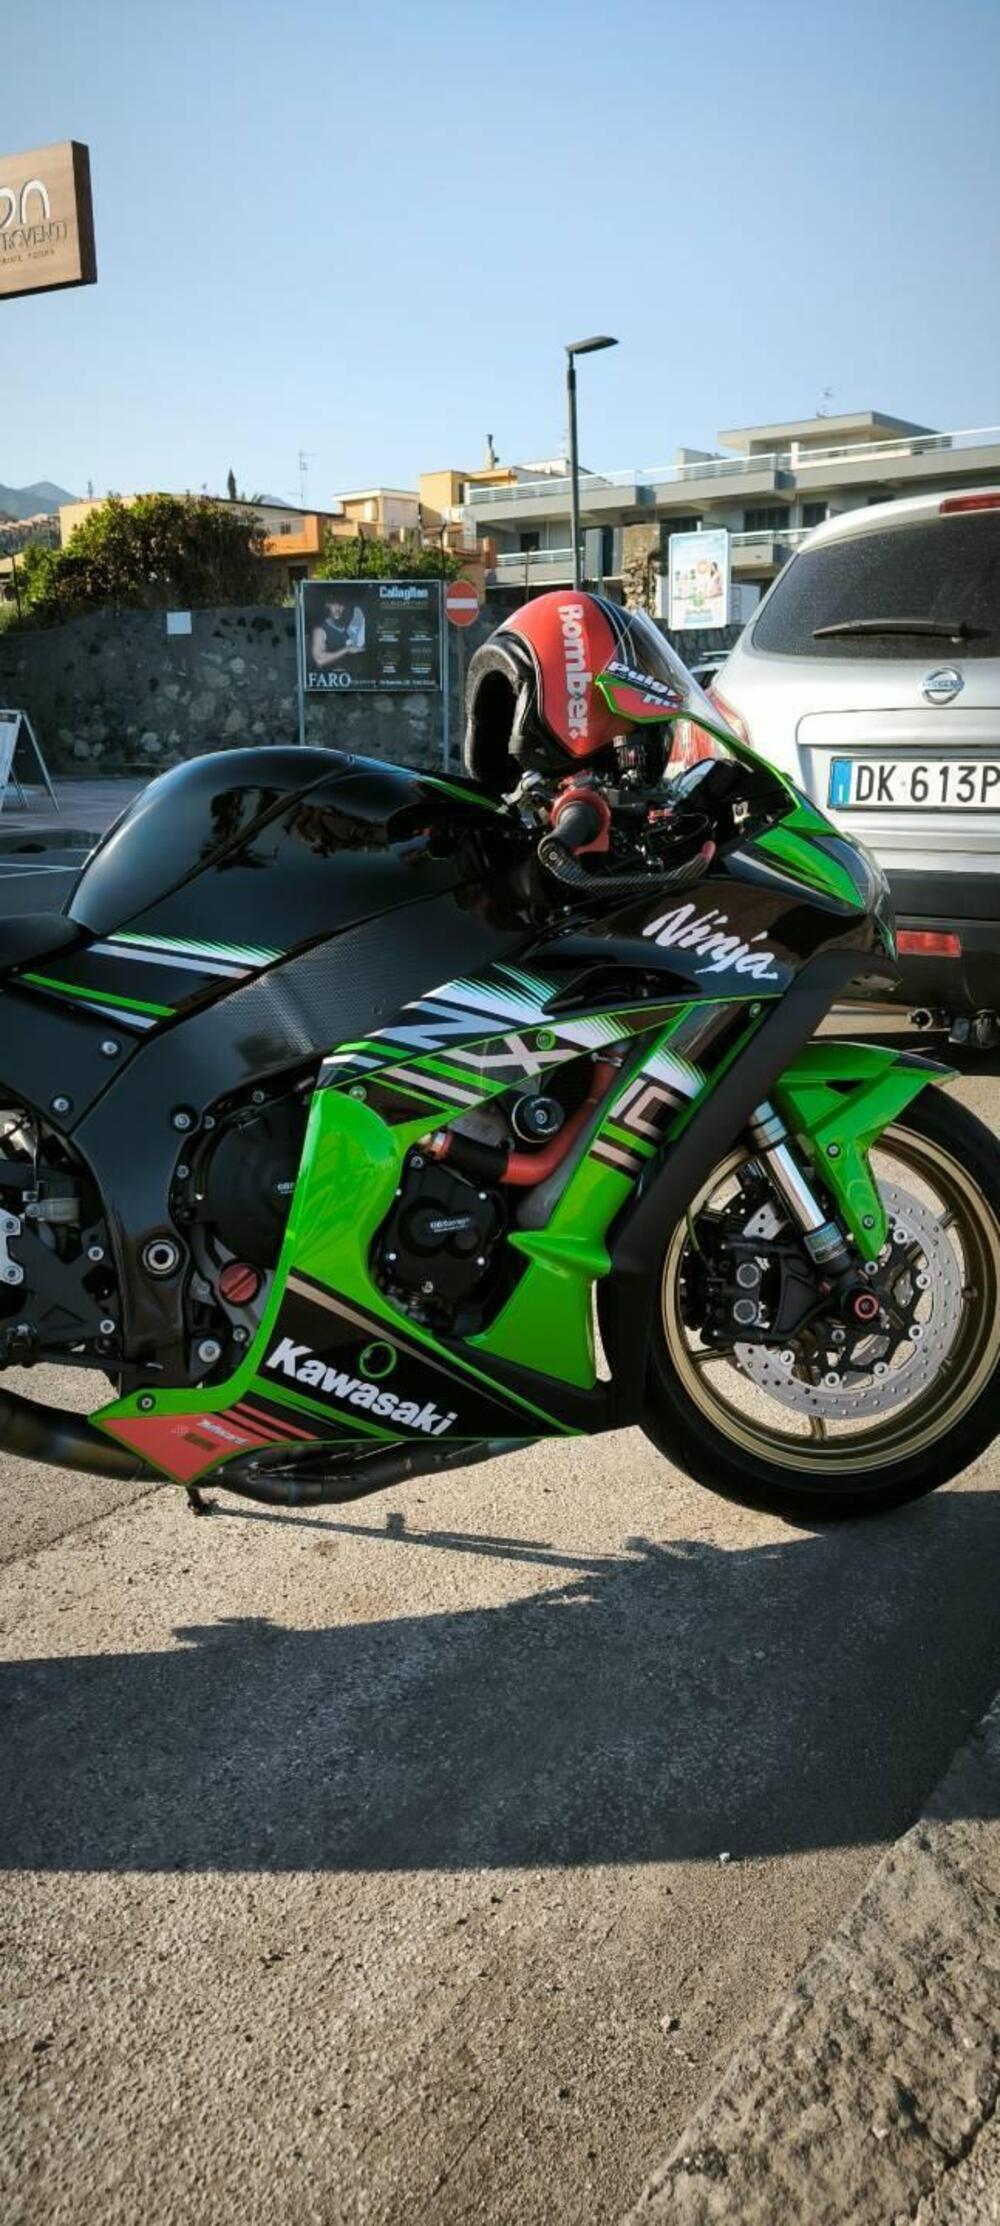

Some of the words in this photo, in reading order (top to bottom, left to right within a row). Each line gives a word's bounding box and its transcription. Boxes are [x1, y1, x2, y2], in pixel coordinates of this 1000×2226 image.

[308, 672, 351, 688] FARO
[856, 765, 897, 802] DK
[910, 765, 1000, 803] 613P
[642, 903, 778, 979] Ninja
[265, 1337, 458, 1436] Kawasaki
